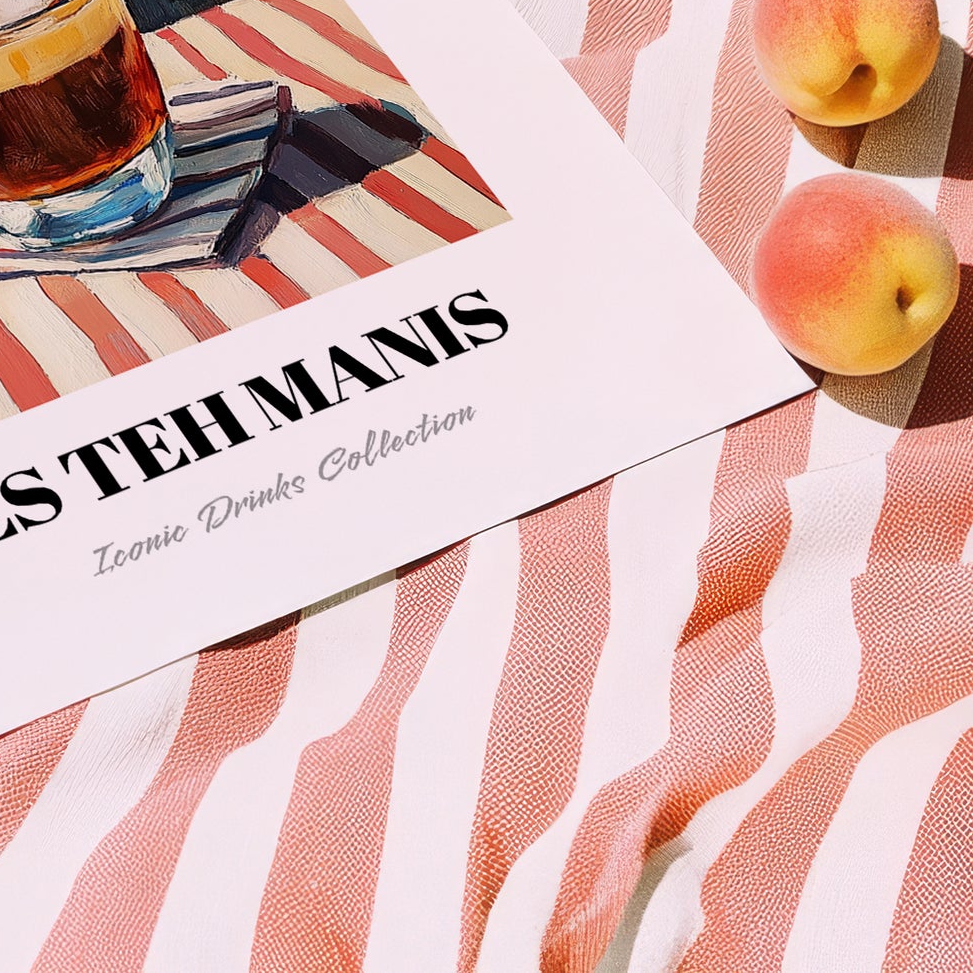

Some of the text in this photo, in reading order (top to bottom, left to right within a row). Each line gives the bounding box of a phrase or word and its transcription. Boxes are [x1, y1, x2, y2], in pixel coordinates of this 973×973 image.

[57, 390, 256, 502] TEH
[238, 288, 510, 432] MANIS
[92, 402, 477, 578] Iconic Drinks Collection
